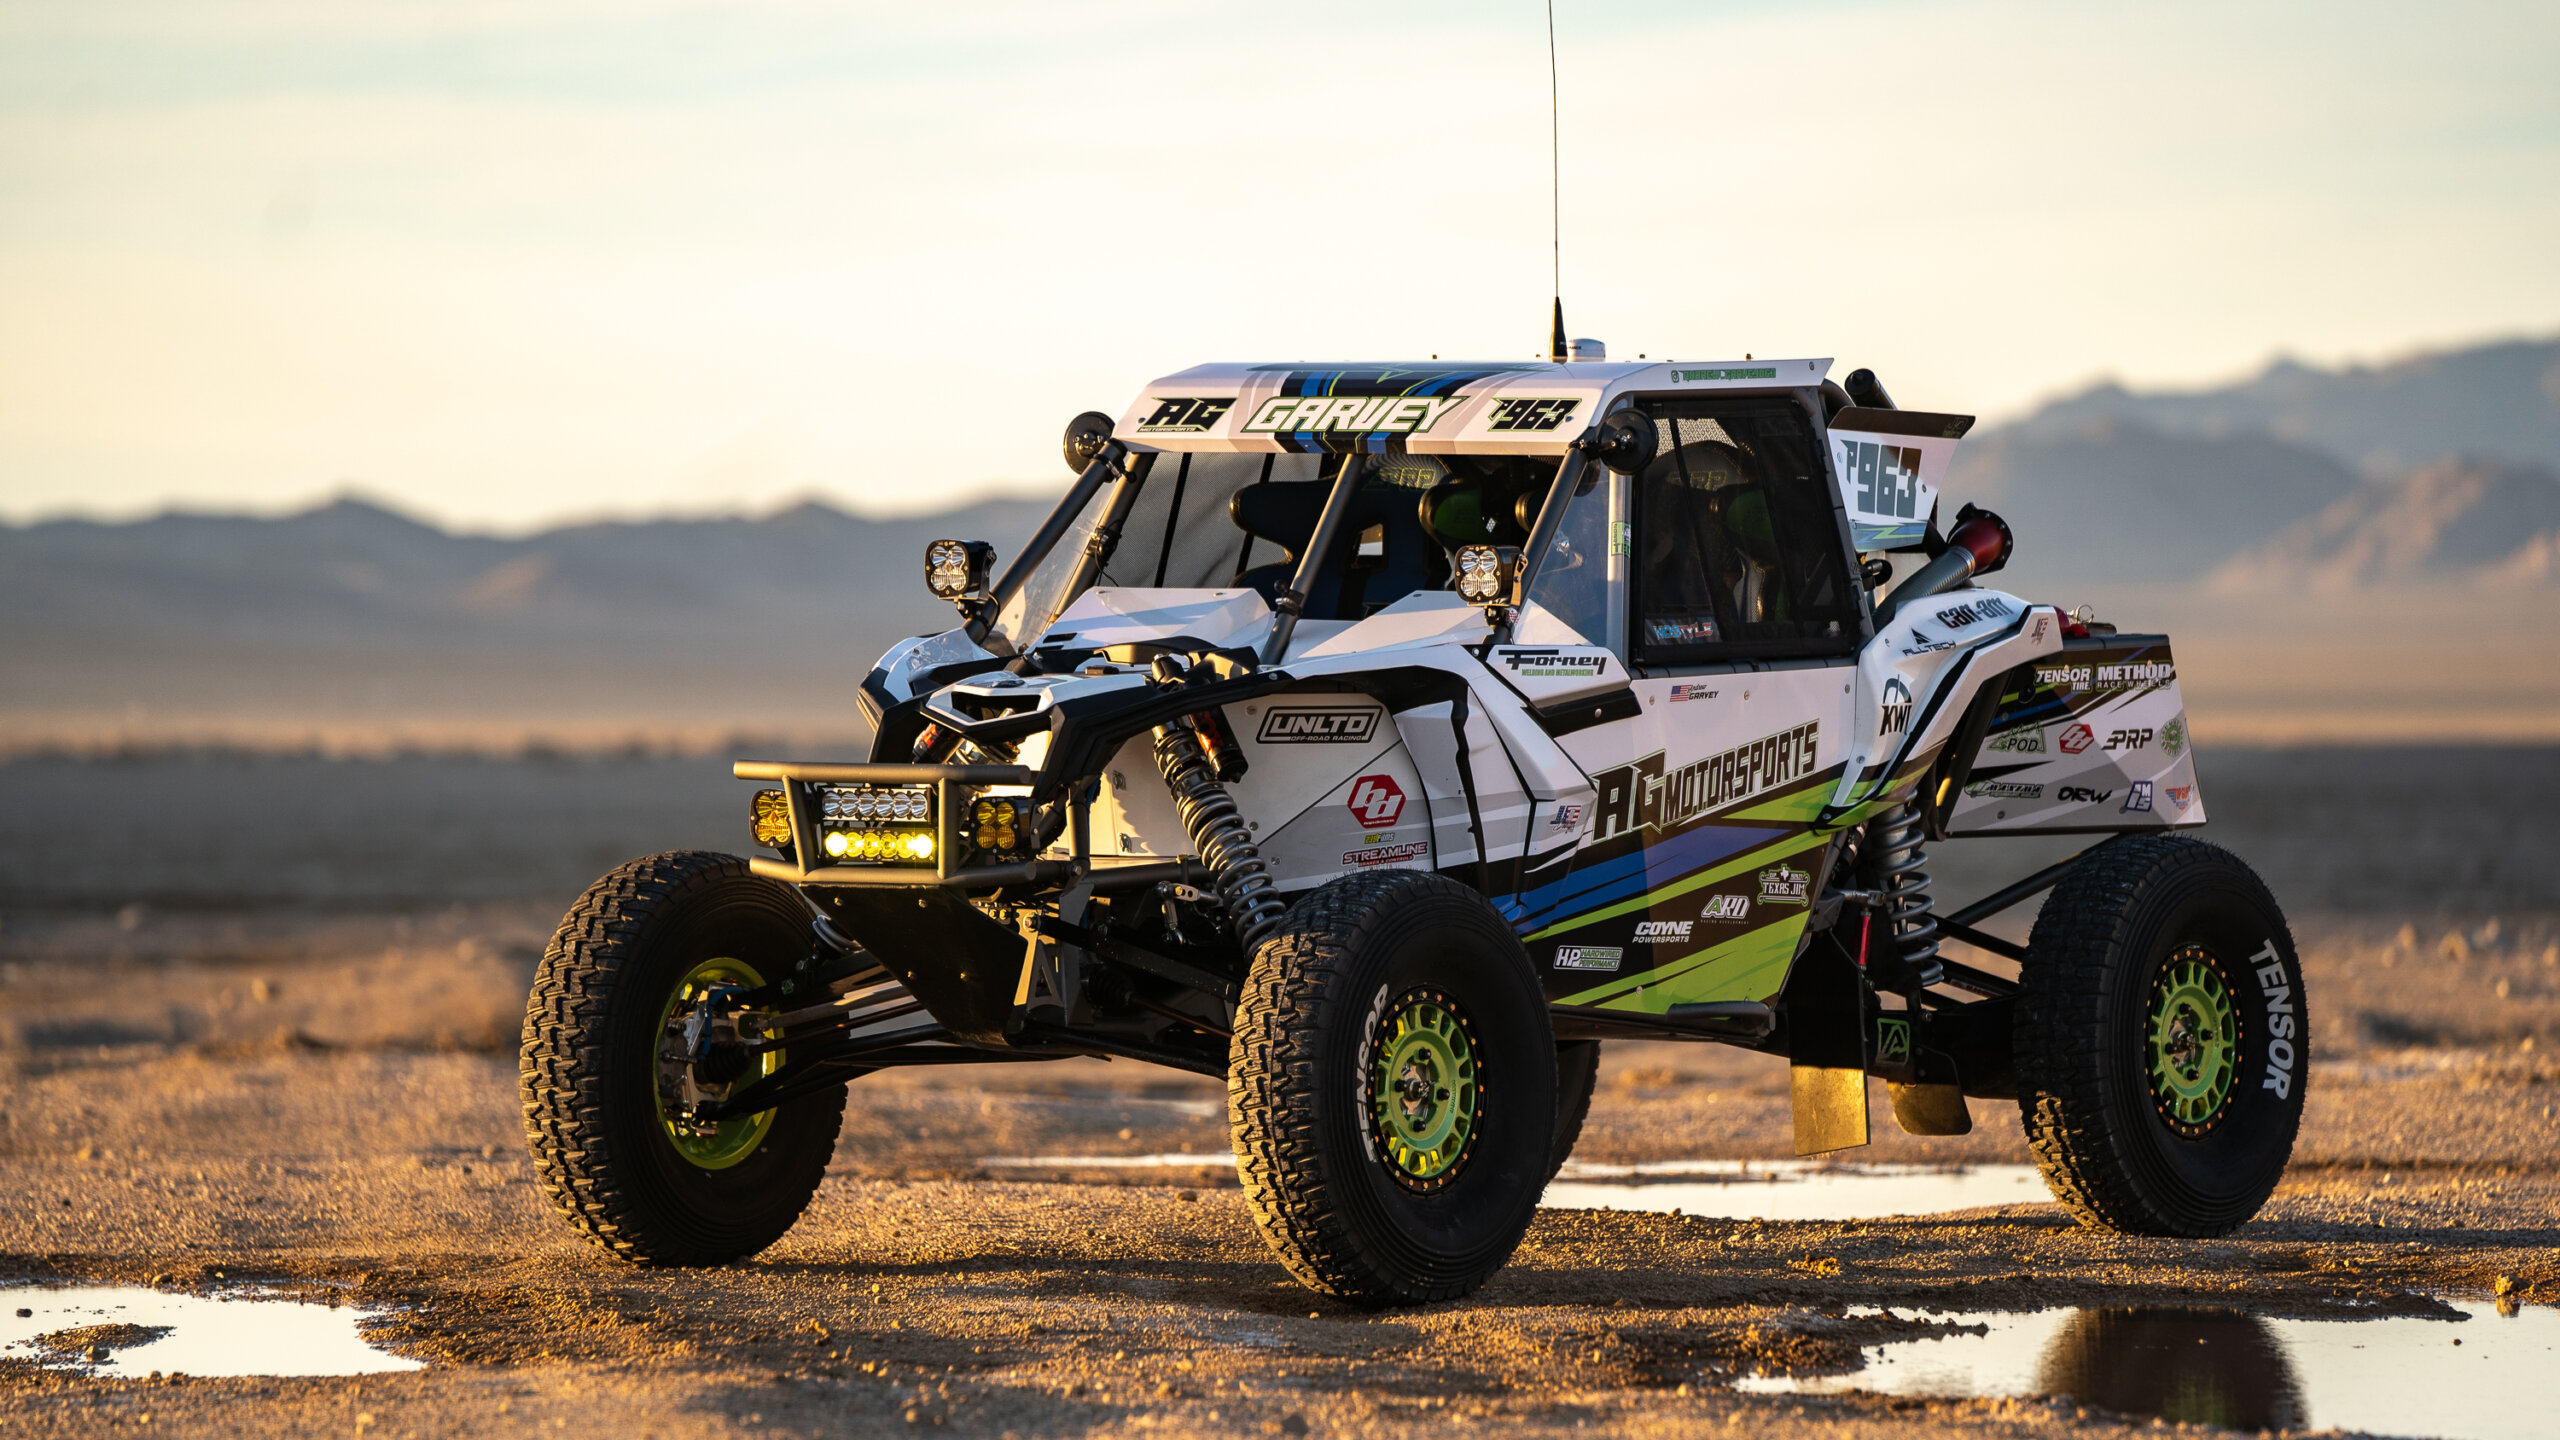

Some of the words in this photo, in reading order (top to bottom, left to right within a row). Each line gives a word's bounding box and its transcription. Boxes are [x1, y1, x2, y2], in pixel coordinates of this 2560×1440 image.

[1143, 397, 1238, 432] AG
[1241, 396, 1470, 433] GARVEY
[1936, 598, 2014, 629] can-am
[1902, 640, 1957, 657] ALLTECH
[1498, 649, 1607, 675] Forney
[2035, 668, 2091, 683] TENSOR
[2097, 663, 2171, 681] METHOD
[2097, 681, 2122, 689] RACE
[1688, 691, 1719, 700] GARVEY
[1269, 716, 1370, 733] UNLTD
[2101, 728, 2153, 750] PRP
[1587, 748, 1667, 845] AG
[1663, 718, 1820, 828] MOTORSPORTS
[2058, 786, 2112, 803] ORW
[1343, 843, 1426, 863] STREAMLINE
[1762, 882, 1789, 894] TEXAS
[1635, 921, 1693, 935] COYNE
[2249, 938, 2296, 1100] TENSOR
